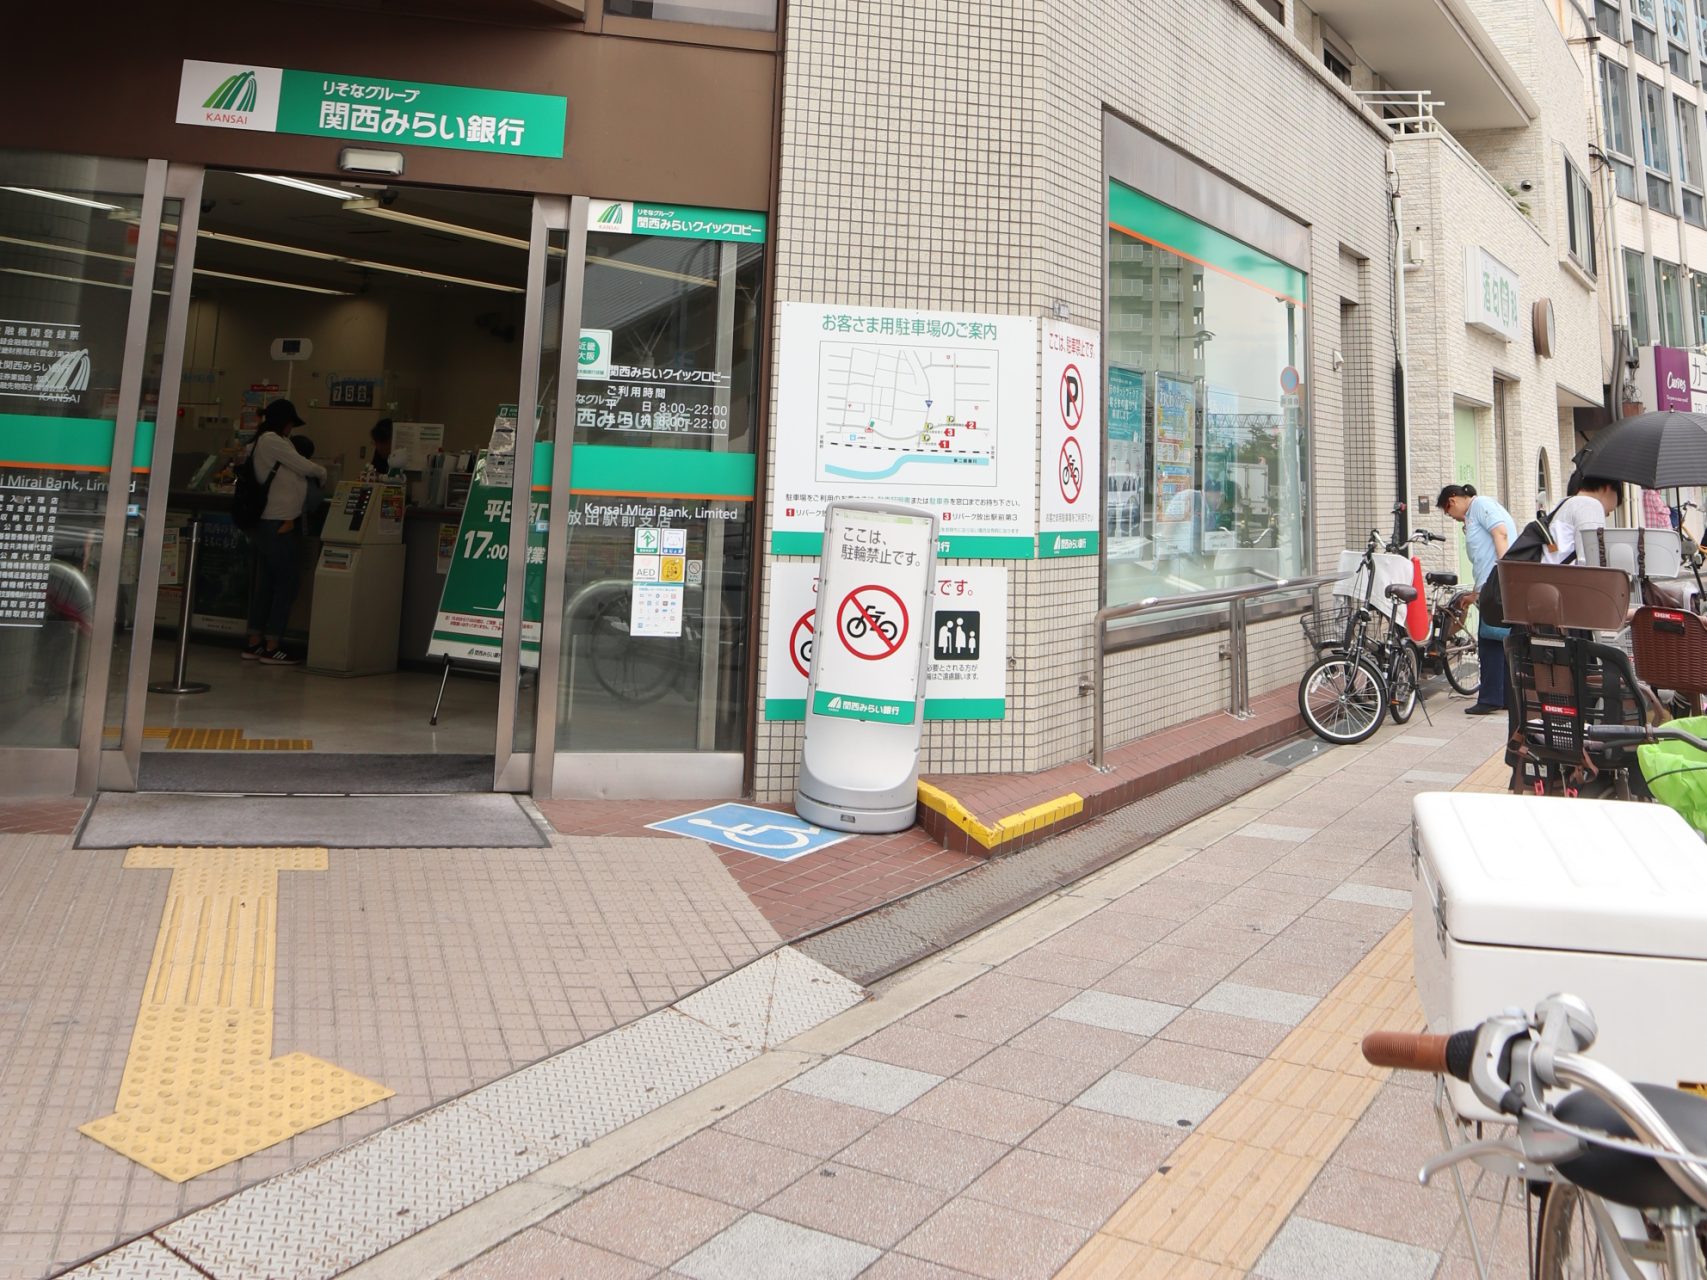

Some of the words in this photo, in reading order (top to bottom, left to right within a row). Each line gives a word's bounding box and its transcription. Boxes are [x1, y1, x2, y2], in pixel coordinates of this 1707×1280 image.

[323, 80, 420, 103] りそなグループ
[206, 112, 247, 125] KANSAI
[319, 101, 525, 147] 関西みらい銀行
[636, 216, 762, 236] 関西みらいクイックロビー
[821, 313, 998, 341] お客さま用駐車場のご案内
[609, 365, 731, 383] 関西みらいクイックロビー
[607, 385, 666, 399] ご利用時間
[8, 475, 42, 488] Mirai
[46, 477, 84, 492] Bank,
[86, 480, 136, 493] Limd
[584, 503, 623, 516] Kansai
[626, 504, 657, 517] Mirai
[659, 506, 692, 520] Bank,
[695, 508, 738, 521] Limited
[464, 531, 507, 560] 17:00
[843, 527, 887, 546] ここは、
[841, 544, 921, 568] 駐輪禁止です。
[636, 568, 655, 577] AED
[842, 700, 900, 716] 関西みらい銀行
